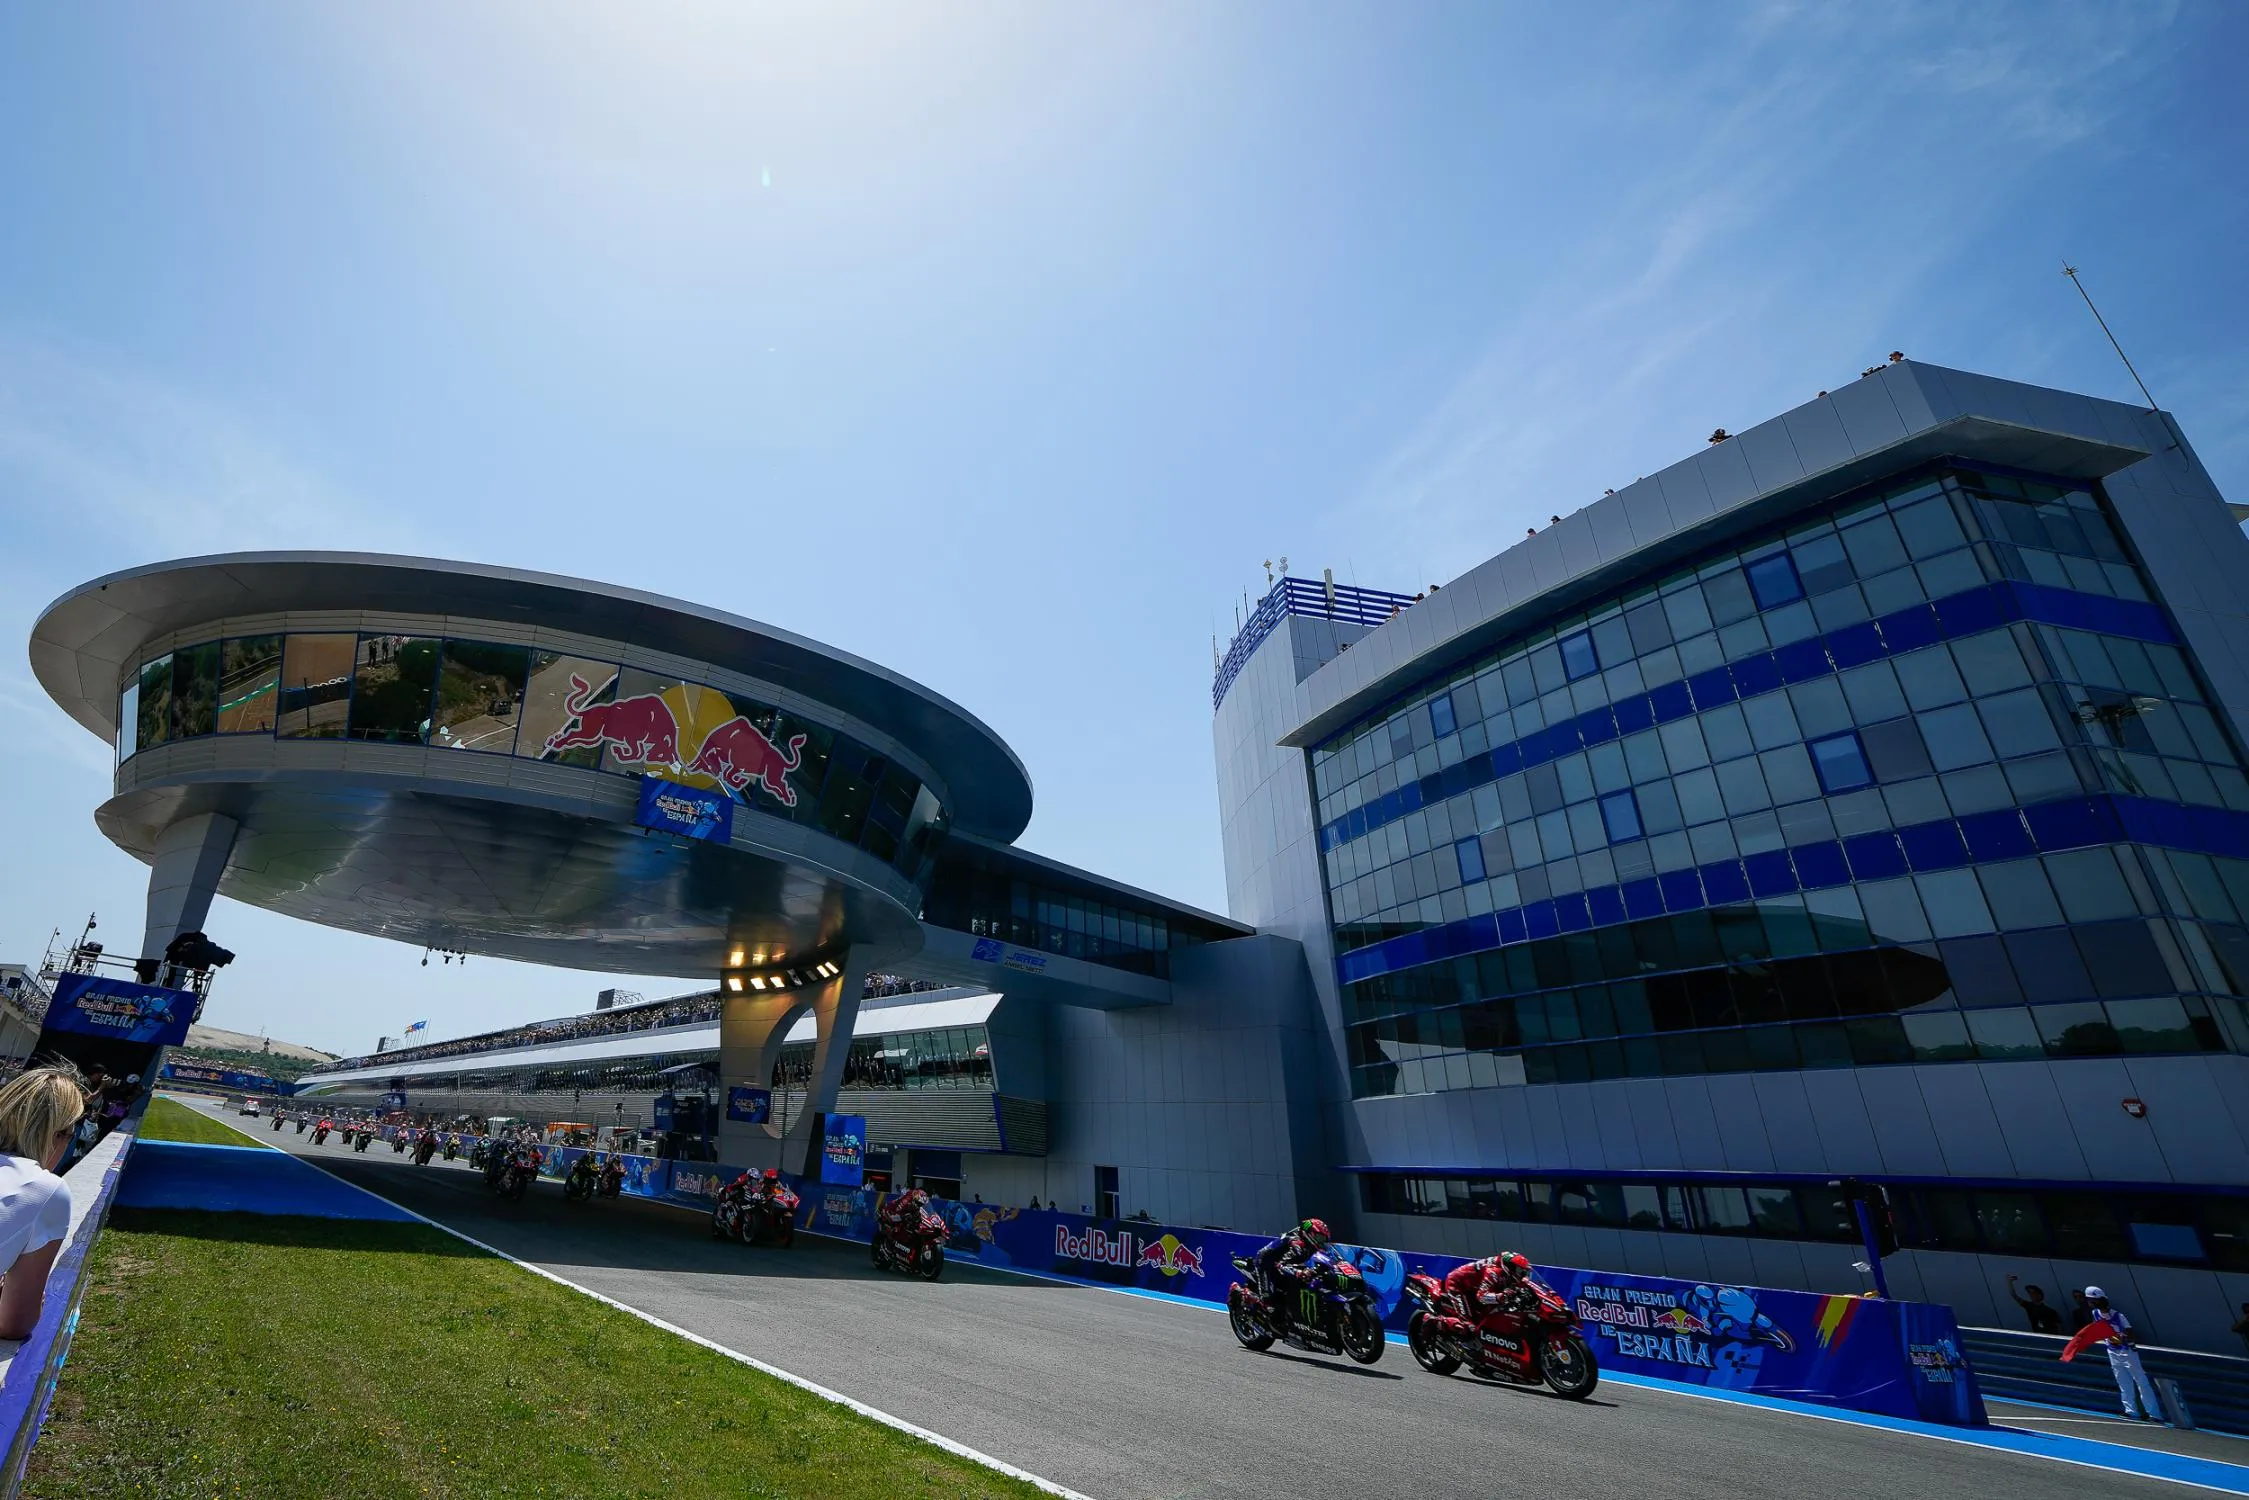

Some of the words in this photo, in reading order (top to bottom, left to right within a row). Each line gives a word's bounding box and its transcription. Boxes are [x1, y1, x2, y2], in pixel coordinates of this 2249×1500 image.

[85, 992, 105, 1001] GRAN
[1584, 1285, 1622, 1301] GRAN
[1624, 1289, 1677, 1308] PREMIO
[1480, 1329, 1518, 1350] Lenovo
[1600, 1323, 1618, 1337] DE
[1616, 1330, 1714, 1368] ESPAÑA
